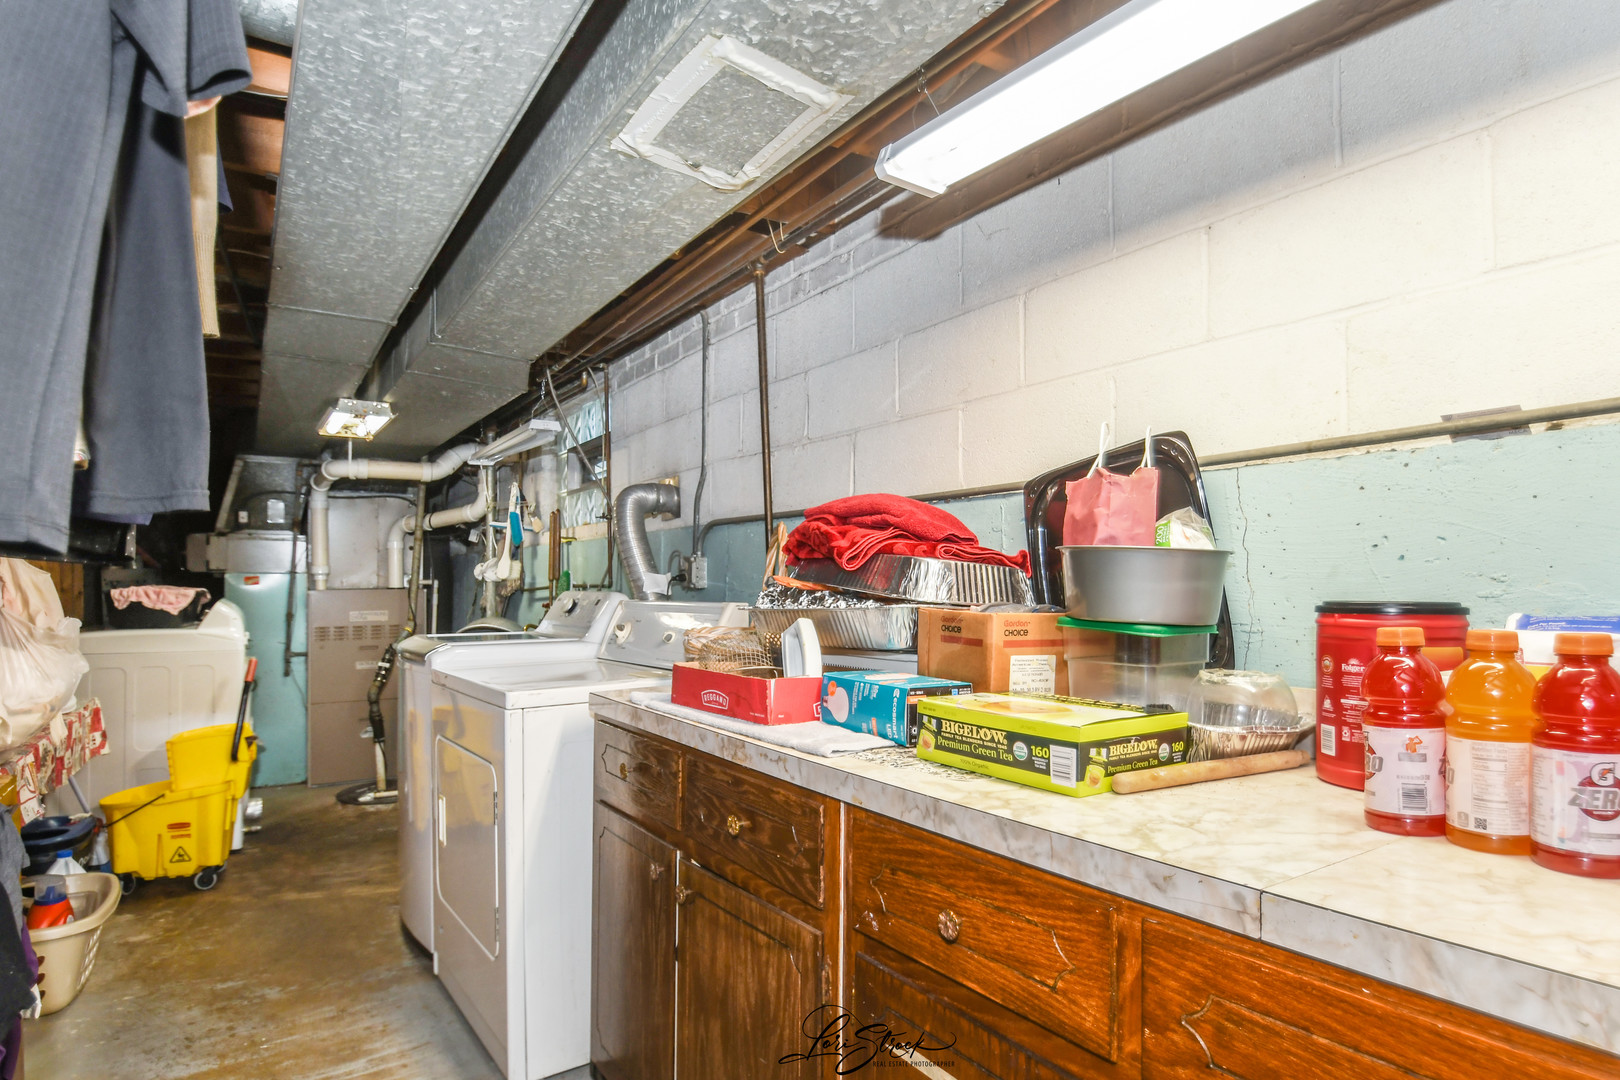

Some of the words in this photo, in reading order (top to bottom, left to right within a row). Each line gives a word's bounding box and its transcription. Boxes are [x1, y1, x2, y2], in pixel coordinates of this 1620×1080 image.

[1155, 525, 1165, 545] 200
[941, 615, 963, 625] Gordon
[1003, 619, 1029, 628] Gordon
[1341, 663, 1366, 673] Folger
[704, 693, 727, 706] REGGANO
[941, 719, 1007, 744] BIGELOW
[937, 735, 971, 752] Premium
[971, 743, 997, 758] Green
[998, 748, 1013, 762] Tea
[1030, 745, 1050, 759] 160
[1109, 739, 1158, 756] BIGELOW
[1171, 741, 1184, 752] 160
[1107, 761, 1132, 773] Premium
[1132, 757, 1149, 770] Green
[1149, 757, 1158, 766] Tea
[1568, 787, 1620, 809] ZER
